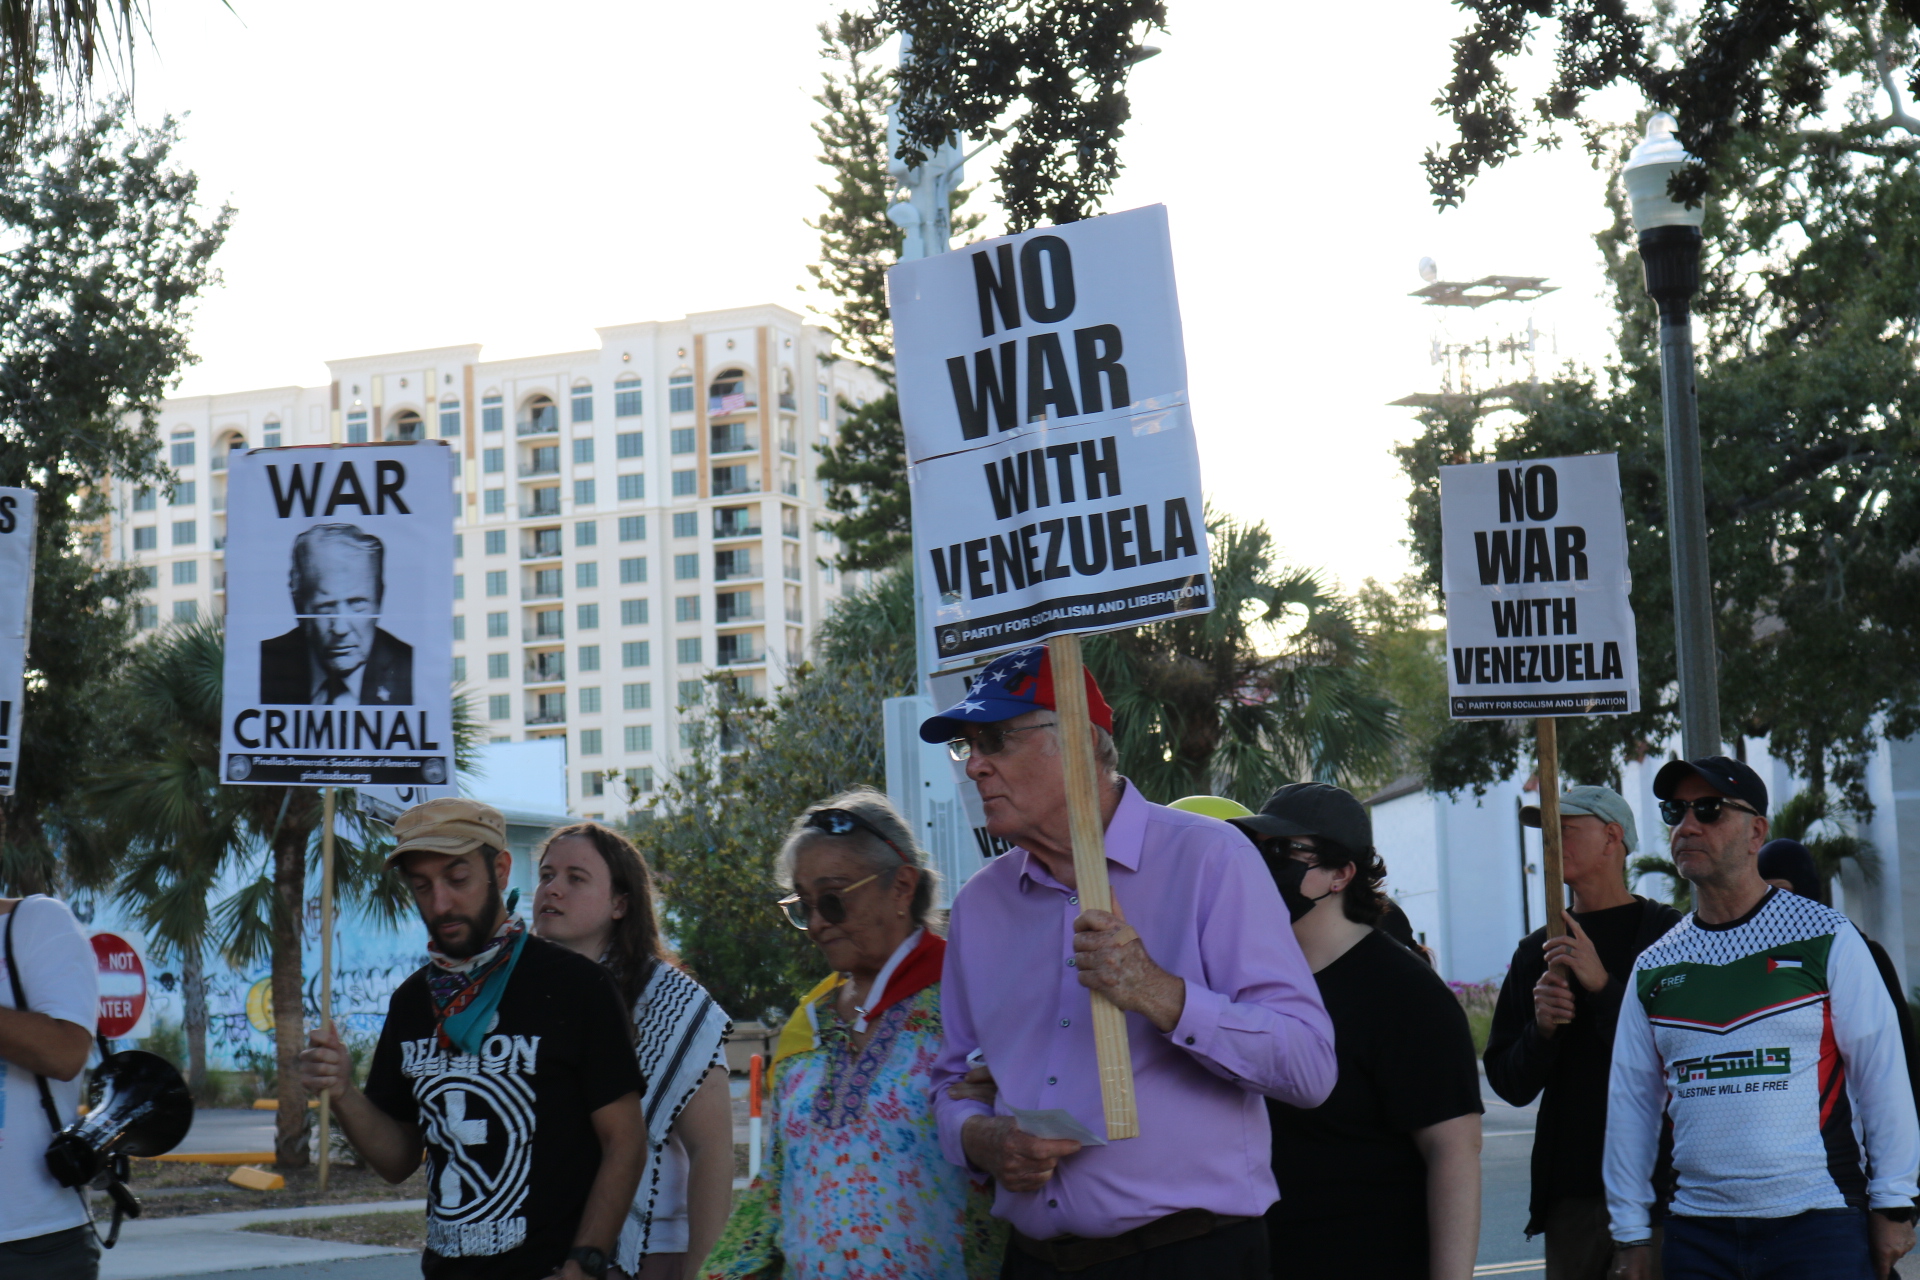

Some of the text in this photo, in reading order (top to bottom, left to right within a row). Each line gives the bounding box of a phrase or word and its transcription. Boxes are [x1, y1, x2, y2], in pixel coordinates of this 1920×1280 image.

[972, 234, 1075, 338] NO
[947, 323, 1130, 441] WAR
[266, 460, 412, 518] WAR
[984, 436, 1121, 521] WITH
[1497, 464, 1558, 523] NO
[930, 497, 1198, 604] VENEZUELA
[1474, 526, 1588, 586] WAR
[962, 623, 1003, 642] PARTY
[1004, 618, 1031, 633] FOR
[1031, 604, 1095, 627] SOCIALISM
[1097, 599, 1126, 614] AND
[1128, 584, 1205, 608] LIBERATION
[1491, 597, 1577, 638] WITH
[1452, 641, 1624, 685] VENEZUELA
[1468, 701, 1494, 710] PARTY
[1496, 701, 1512, 709] FOR
[1512, 700, 1554, 709] SOCIALISM
[1555, 699, 1574, 708] AND
[1575, 697, 1626, 707] LIBERATION
[234, 708, 439, 751] CRIMINAL
[108, 952, 134, 970] NOT
[1661, 974, 1687, 987] FREE
[97, 1001, 133, 1018] NTER
[1718, 1083, 1742, 1094] WILL
[1745, 1082, 1759, 1093] BE
[1762, 1081, 1788, 1091] FREE
